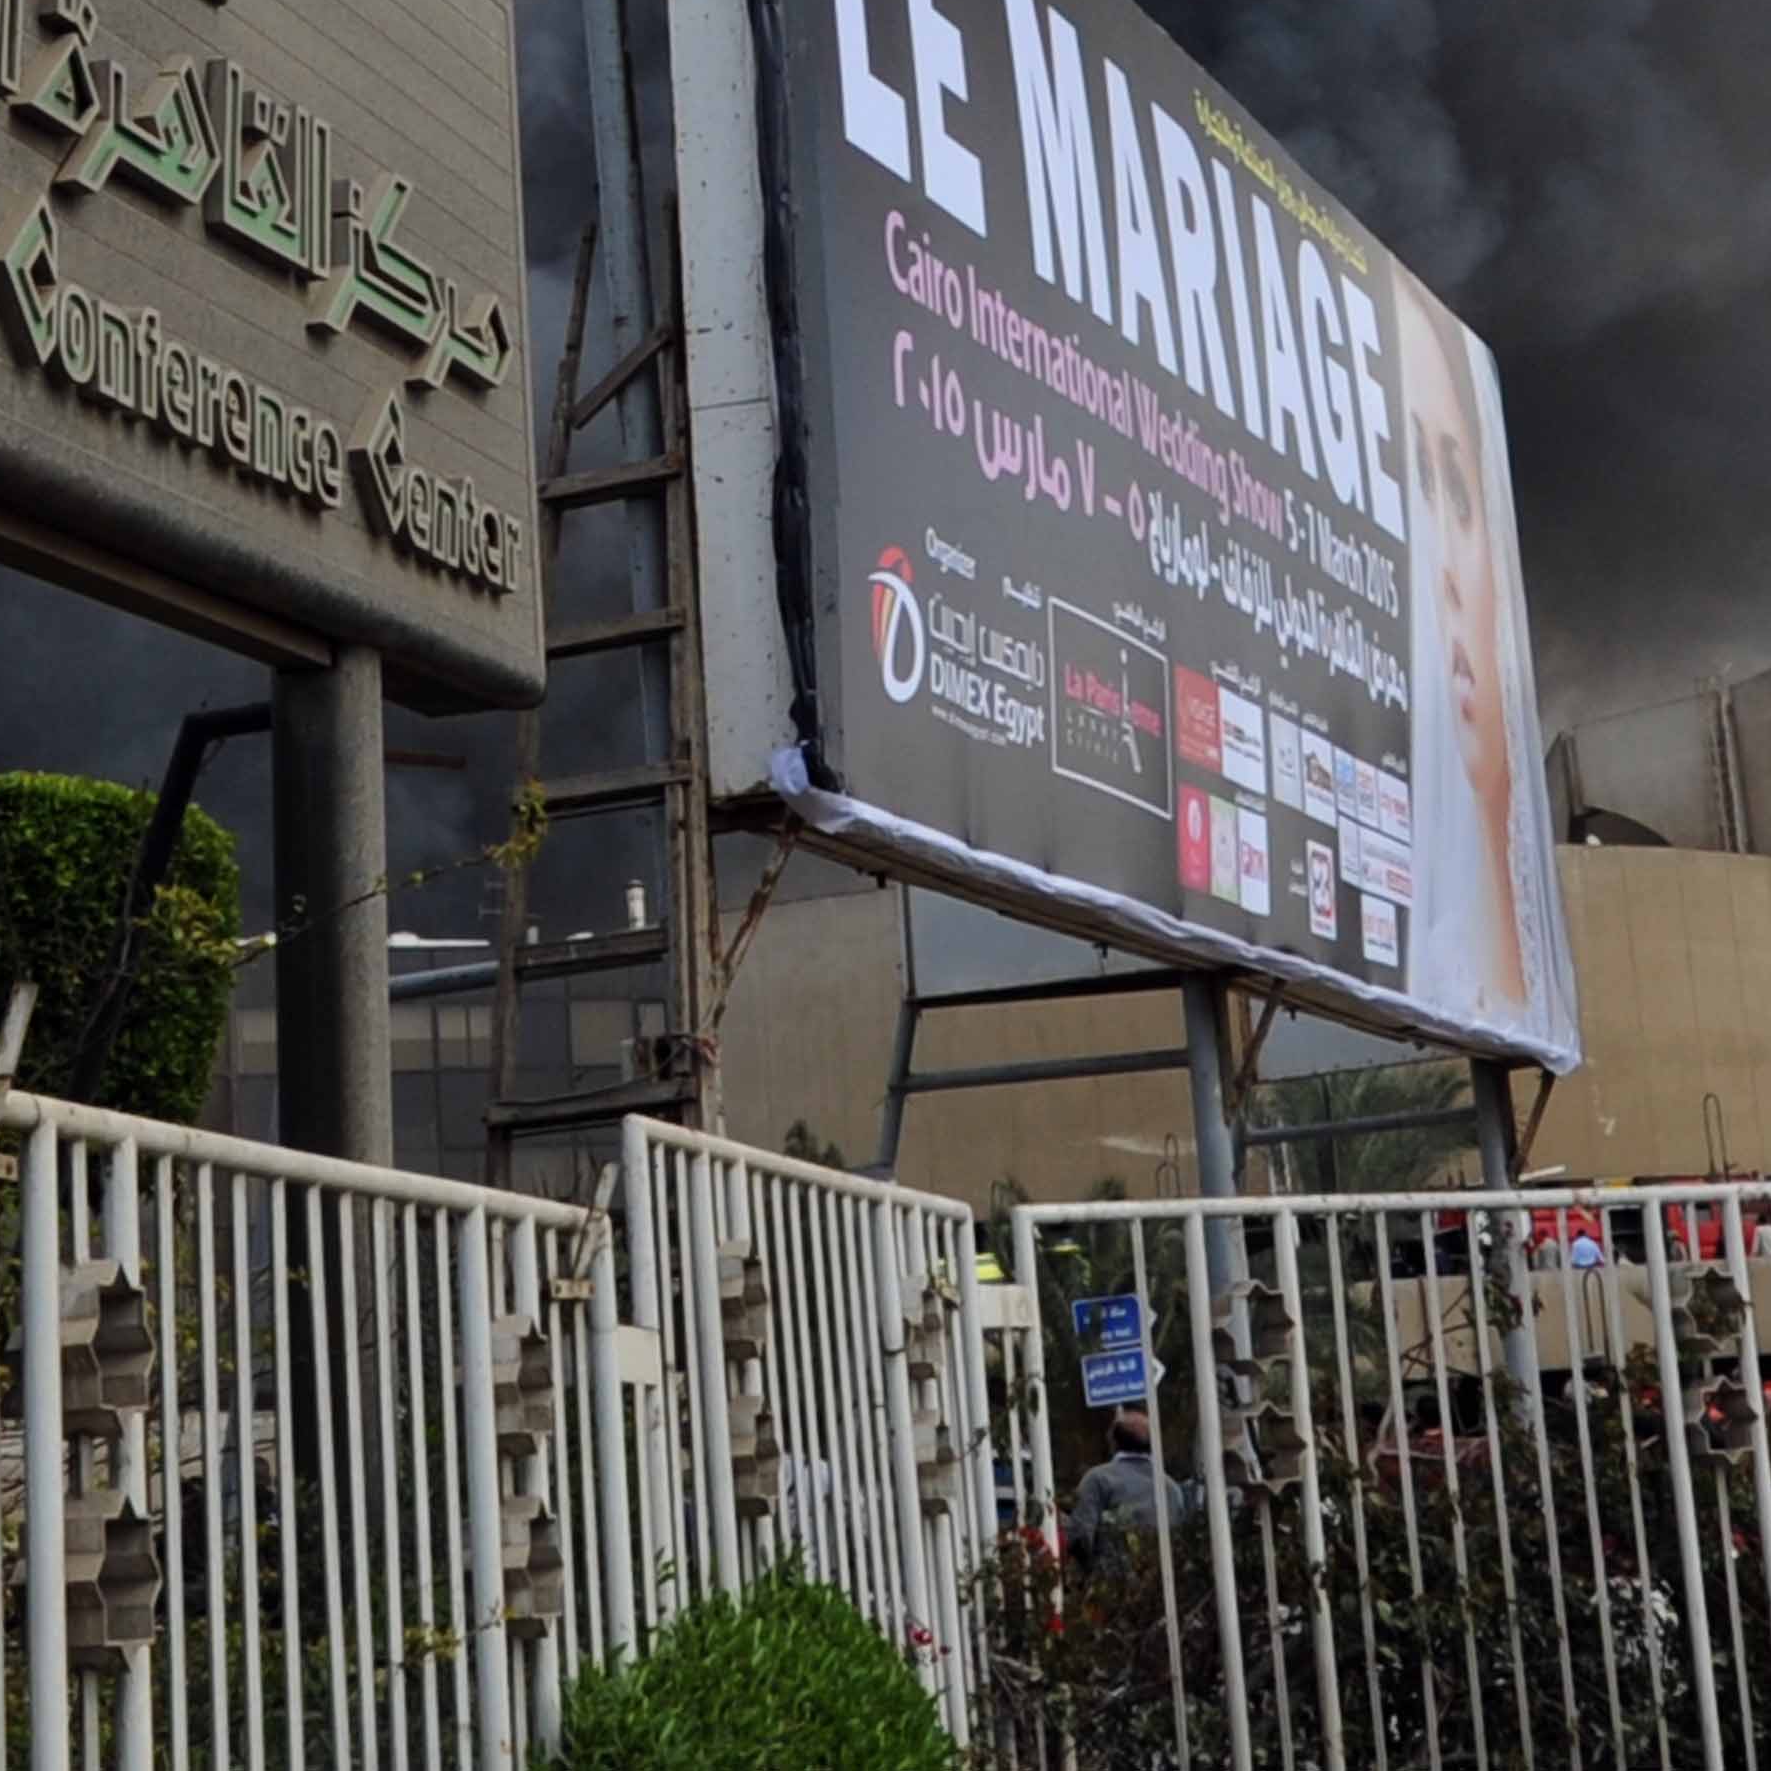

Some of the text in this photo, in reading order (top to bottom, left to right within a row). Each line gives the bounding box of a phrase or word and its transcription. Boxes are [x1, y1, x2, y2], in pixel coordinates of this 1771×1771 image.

[305, 173, 513, 388] مركز
[885, 209, 963, 329] Cairo
[967, 264, 1133, 439] International
[1133, 376, 1229, 527] Wedding
[1229, 448, 1283, 541] Show
[1317, 507, 1363, 598] March
[1363, 541, 1400, 619] 2015
[893, 329, 966, 437] ٢٠١٥
[349, 388, 522, 593] Center
[973, 399, 1072, 514] مارس
[1076, 439, 1096, 517] ٧
[930, 651, 1045, 748] DIMEX Egypt
